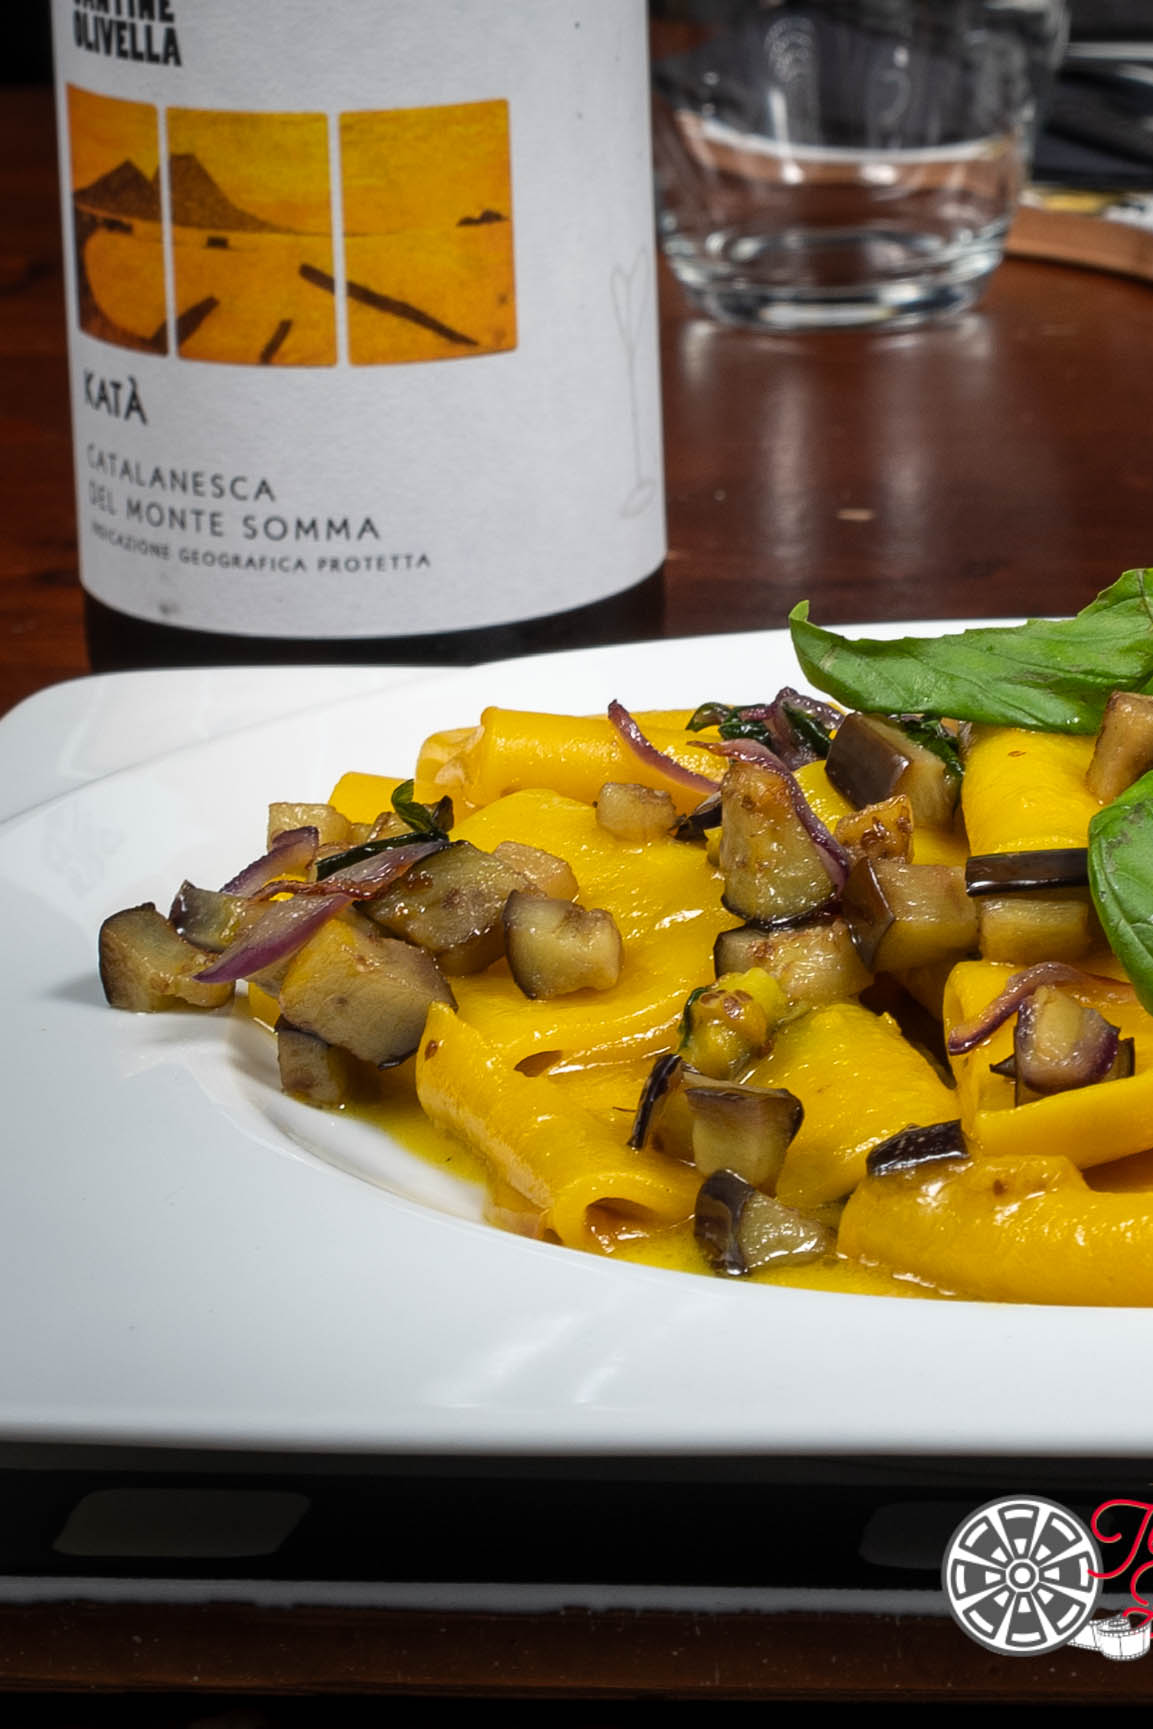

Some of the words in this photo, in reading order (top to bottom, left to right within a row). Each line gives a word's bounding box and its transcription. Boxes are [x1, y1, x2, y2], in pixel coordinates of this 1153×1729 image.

[73, 10, 181, 67] OLIVELLA
[84, 370, 147, 426] KATÀ
[87, 443, 276, 502] CATALANESCA
[89, 480, 117, 516] DEL
[126, 497, 224, 537] MONTE
[242, 514, 380, 541] SOMMA
[178, 547, 306, 573] GEOGRAFICA
[317, 553, 431, 572] PROTETTA
